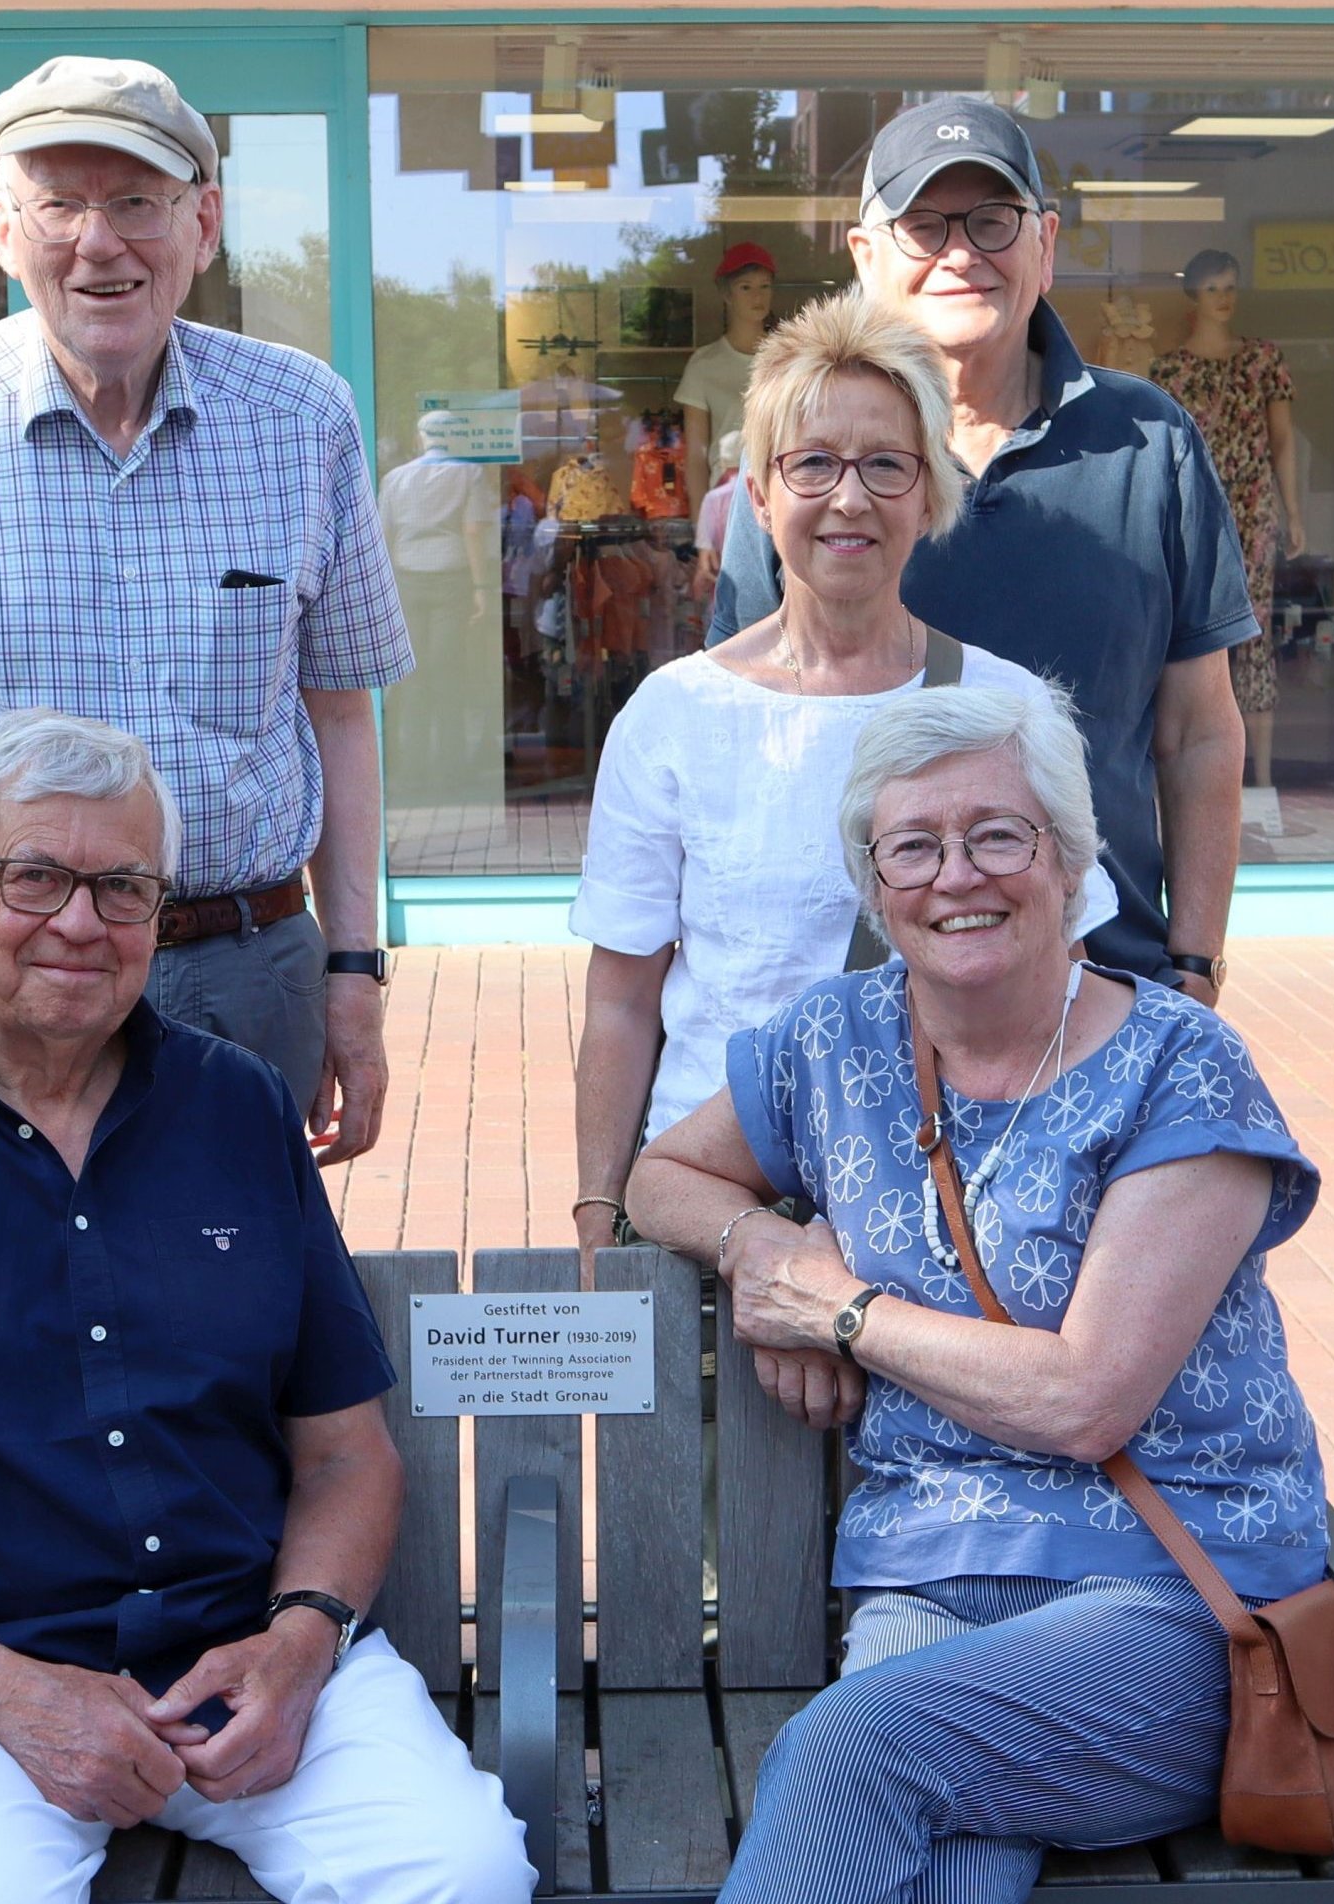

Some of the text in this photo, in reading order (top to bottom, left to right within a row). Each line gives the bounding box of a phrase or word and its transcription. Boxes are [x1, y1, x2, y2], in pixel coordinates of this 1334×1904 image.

[936, 124, 970, 141] OR
[201, 1227, 240, 1236] GANT
[483, 1303, 580, 1316] Gestiftet von
[427, 1327, 637, 1345] David Turner (1930-2019)
[488, 1355, 507, 1365] der
[512, 1354, 564, 1366] Twinning
[568, 1352, 632, 1364] Association
[450, 1369, 614, 1382] der Partnerstadt Bromsgrove
[458, 1389, 609, 1404] an die Stadt Gronau
